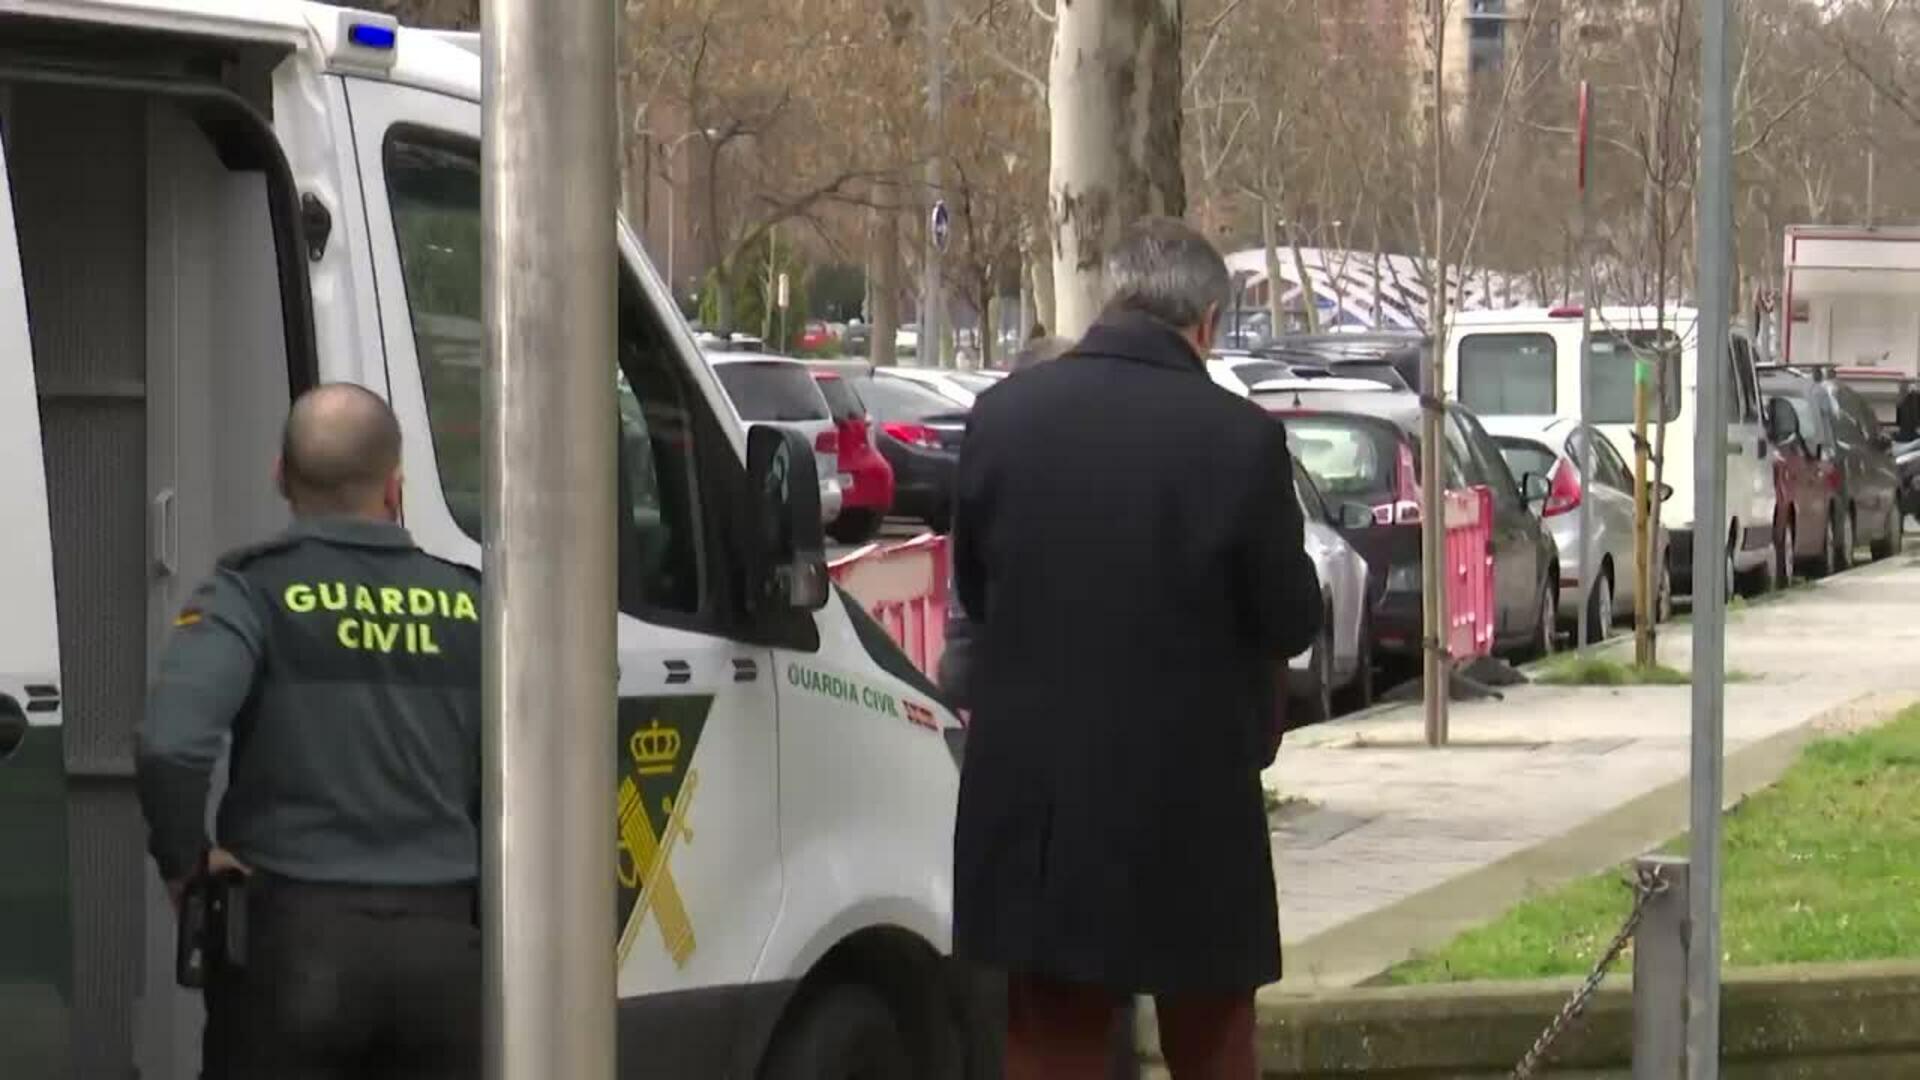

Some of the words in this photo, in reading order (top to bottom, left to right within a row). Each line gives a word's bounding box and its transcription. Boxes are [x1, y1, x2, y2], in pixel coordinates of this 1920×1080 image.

[285, 582, 479, 621] GUARDIA
[337, 617, 441, 653] CIVIL
[787, 662, 860, 705] GUARDIA
[862, 685, 899, 718] CIVIL
